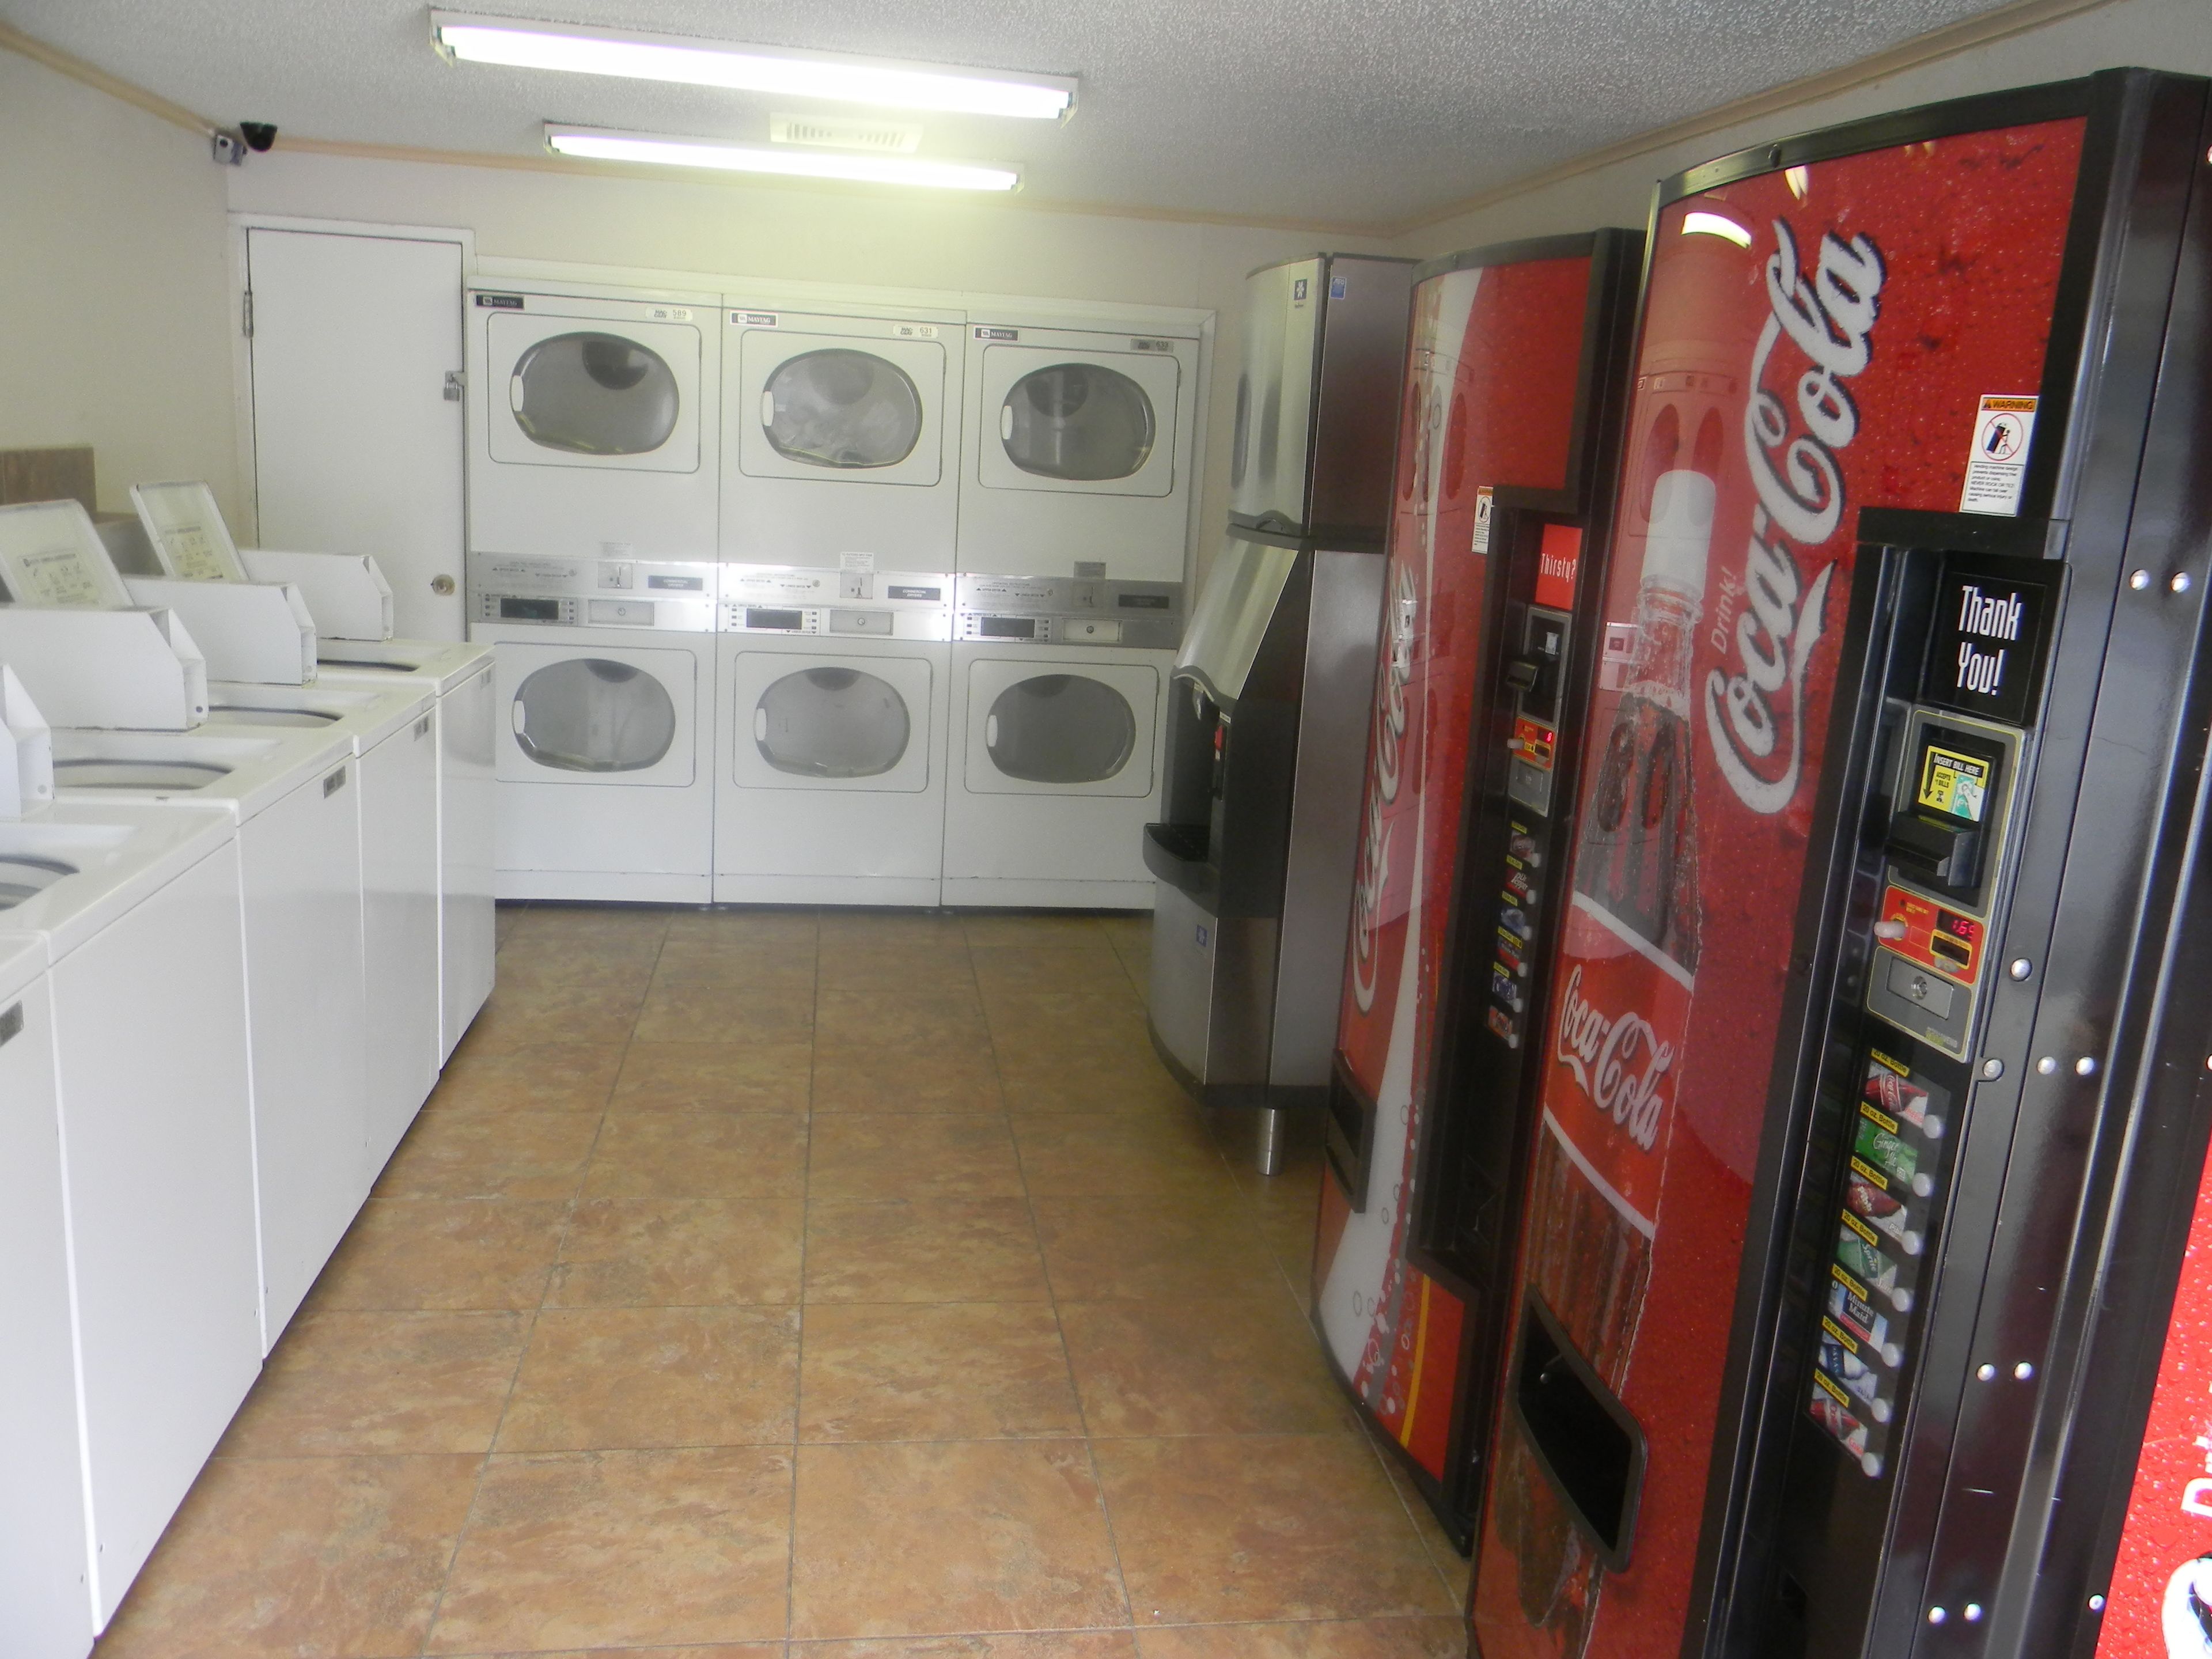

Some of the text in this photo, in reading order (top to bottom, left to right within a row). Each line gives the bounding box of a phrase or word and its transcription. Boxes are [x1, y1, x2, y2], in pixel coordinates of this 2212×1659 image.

[1993, 400, 2033, 410] WARNING
[1705, 215, 1883, 813] Coca-Cola
[1540, 552, 1576, 583] Thirsty?
[1709, 566, 1738, 655] Drink!
[1958, 585, 2022, 641] Thank
[1956, 641, 2005, 696] You!
[1933, 753, 1980, 775] INSERT BILL HERE
[1558, 963, 1676, 1151] Coca-Cola
[1873, 1132, 1900, 1158] Ginger
[1847, 1291, 1874, 1316] Minute
[1849, 1303, 1869, 1324] Maid
